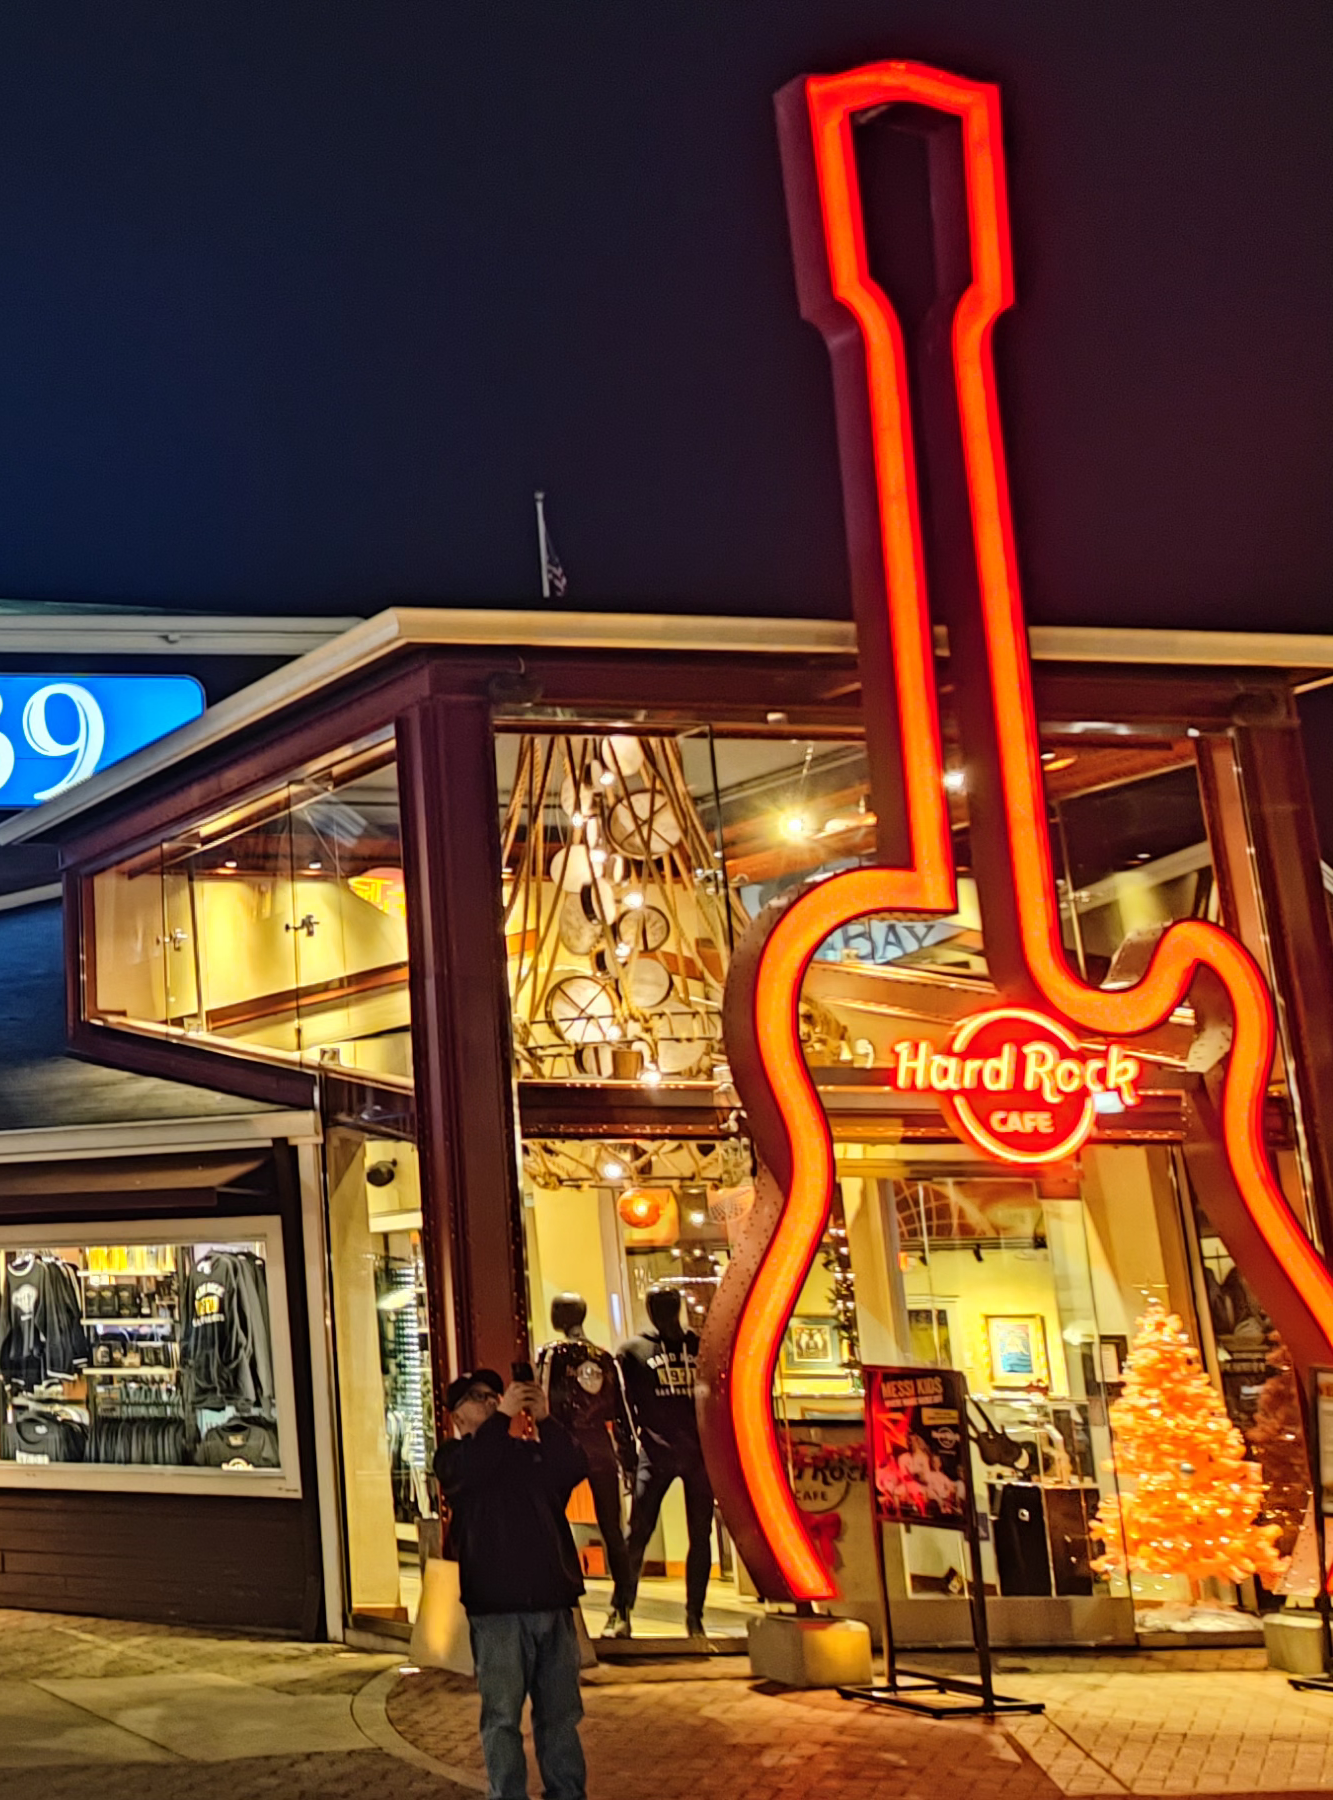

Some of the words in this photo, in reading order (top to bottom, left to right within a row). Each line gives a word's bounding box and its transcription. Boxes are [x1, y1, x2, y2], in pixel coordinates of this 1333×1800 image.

[894, 1041, 1017, 1091] Hard
[1021, 1041, 1140, 1105] Rock
[990, 1111, 1055, 1133] CAFE
